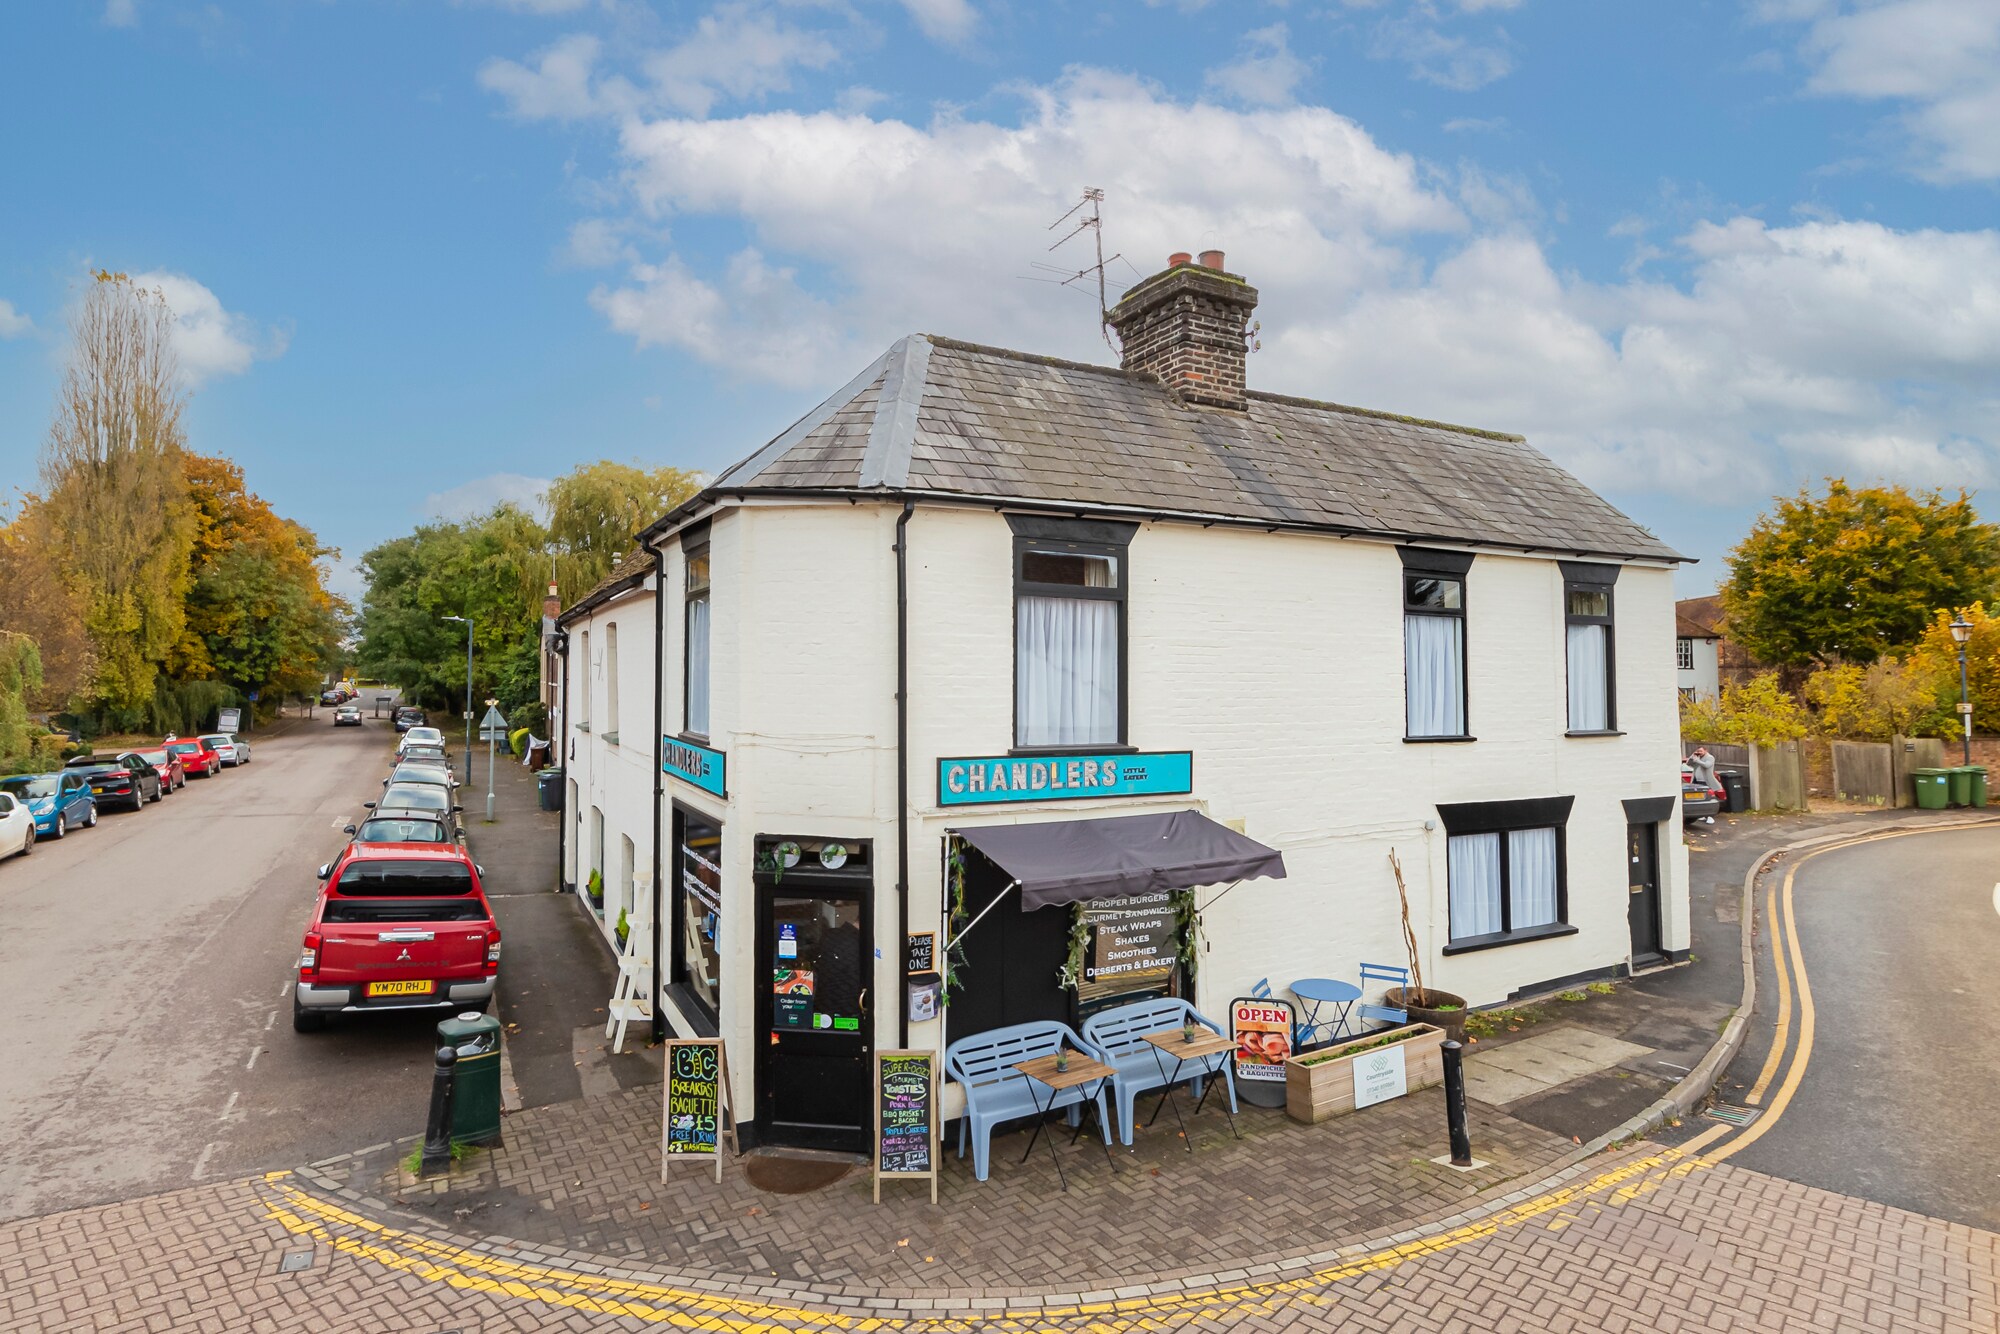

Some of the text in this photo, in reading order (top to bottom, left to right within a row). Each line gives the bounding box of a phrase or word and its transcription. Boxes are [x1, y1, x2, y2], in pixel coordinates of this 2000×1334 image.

[664, 742, 703, 777] CHANDLERS
[948, 759, 1118, 794] CHANDLERS
[1092, 893, 1170, 909] PROPER BURGERS
[1086, 911, 1123, 924] OURMET
[1099, 920, 1162, 935] STEAK WRAPS
[909, 936, 932, 946] PLEASE
[1115, 935, 1150, 946] SHAKES
[911, 946, 931, 957] TAKE
[1107, 947, 1157, 960] SMOOTHIES
[909, 957, 930, 969] ONE
[1086, 956, 1176, 977] DESSERTS & BAKERY
[375, 981, 426, 992] YM70 RHJ
[1237, 1008, 1287, 1023] OPEN
[892, 1076, 922, 1084] GOURMET
[671, 1079, 718, 1100] BREAKFAST
[884, 1083, 926, 1094] TOASTIES
[670, 1097, 718, 1116] BAGUETTE
[908, 1101, 924, 1109] BELLY
[882, 1110, 925, 1118] BBQ BRISKET
[696, 1114, 716, 1131] £5
[670, 1129, 718, 1144] FREE DRINK
[884, 1125, 928, 1136] TRIPLE CHEESE
